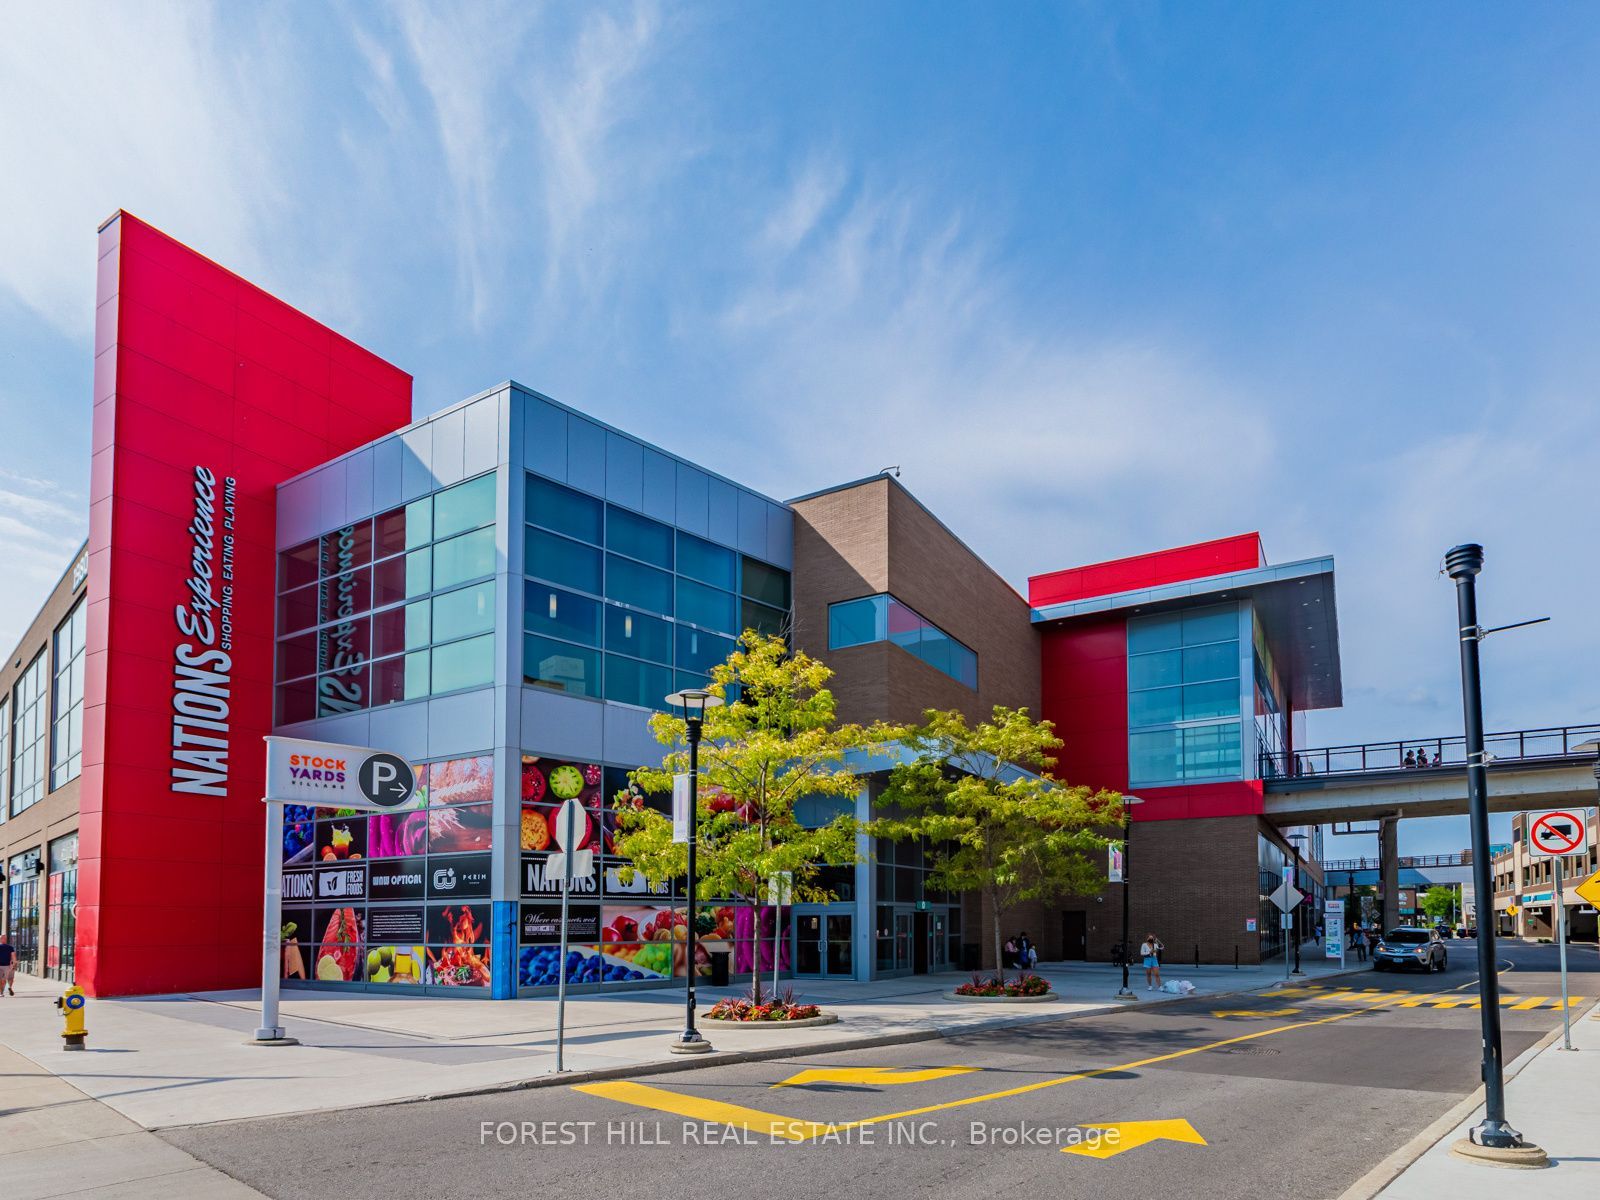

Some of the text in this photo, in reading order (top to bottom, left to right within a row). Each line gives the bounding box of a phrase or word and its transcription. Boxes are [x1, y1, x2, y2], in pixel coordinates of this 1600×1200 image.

[221, 476, 236, 651] SHOPPING. EATING. PLAYING
[172, 465, 232, 797] NATIONS Experience
[289, 766, 346, 783] YARDS
[289, 754, 397, 796] STOCK P
[282, 873, 313, 898] ATIONS
[347, 870, 364, 883] FRESH
[391, 874, 422, 885] OPTICAL
[527, 863, 597, 892] NANS
[346, 883, 363, 896] FOODS
